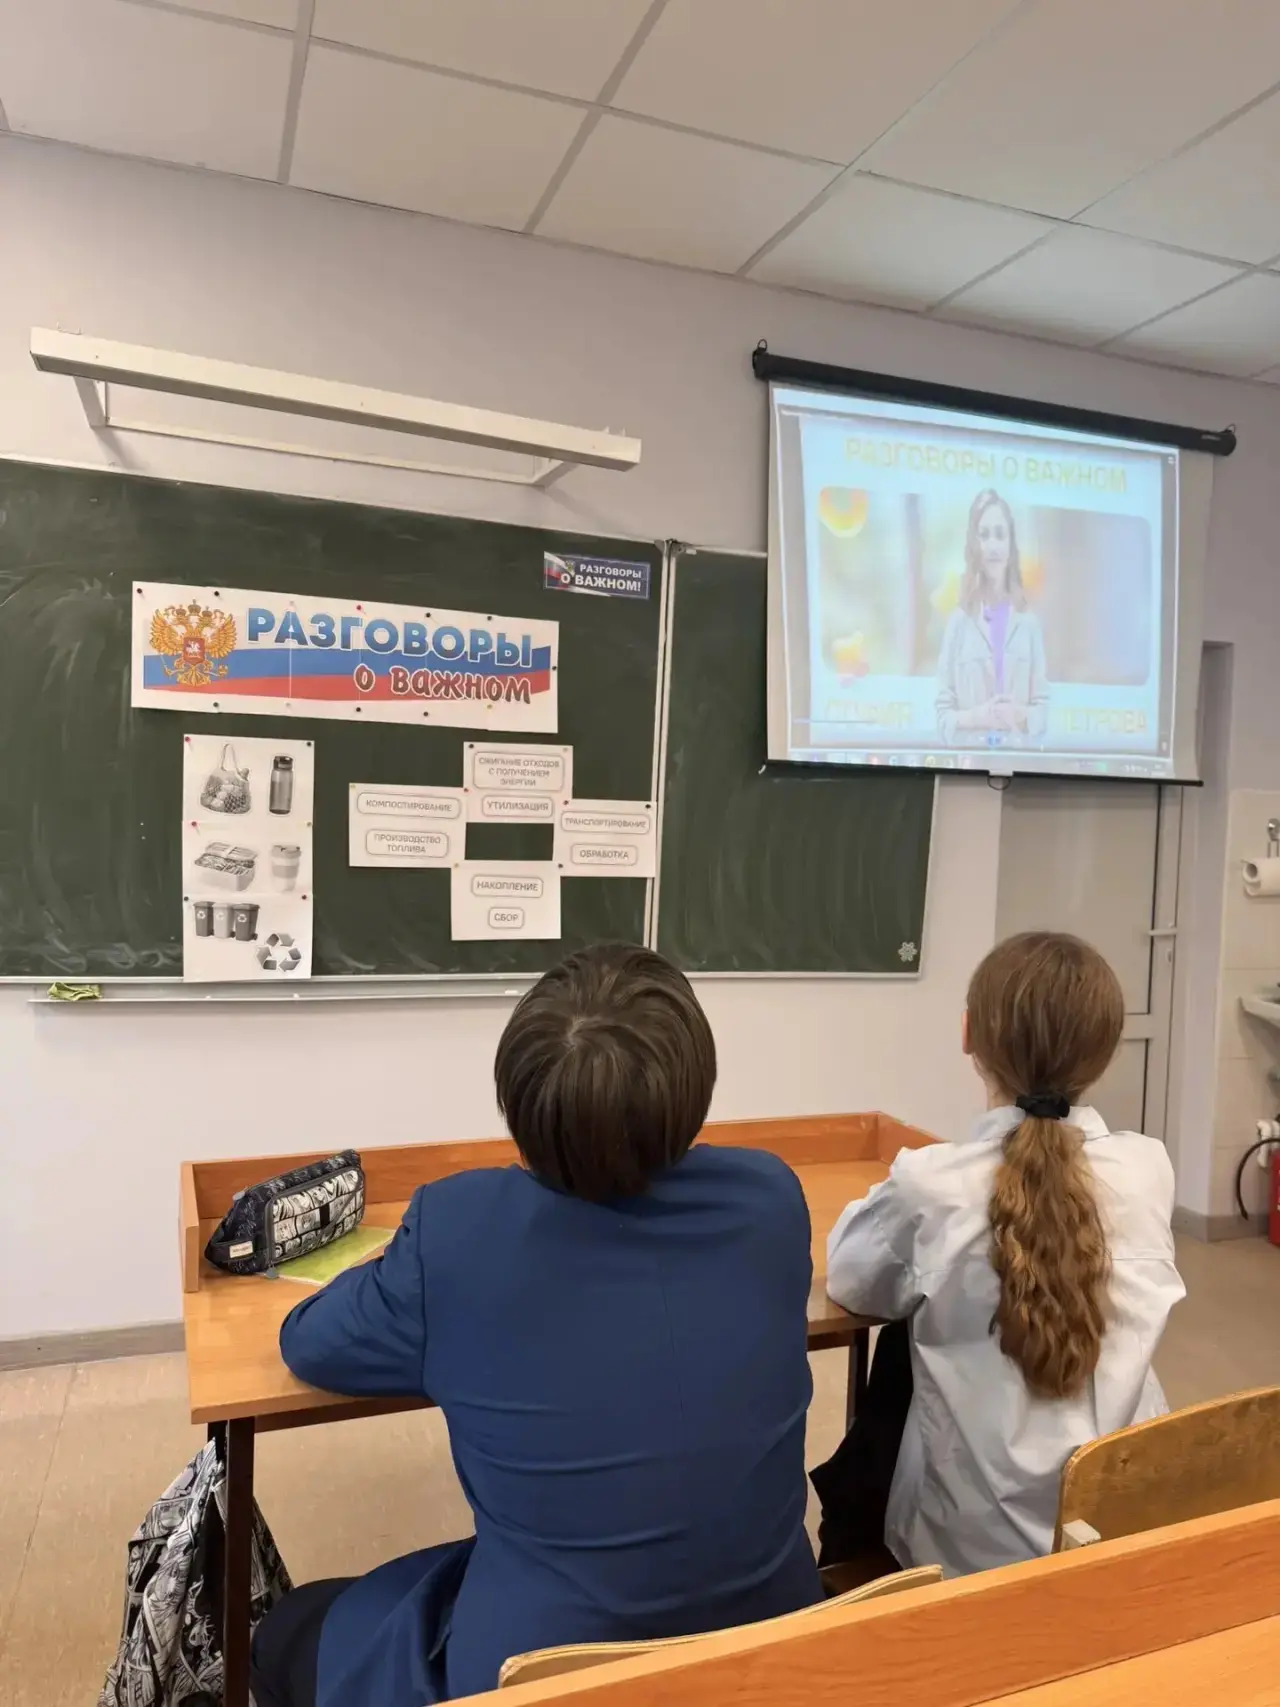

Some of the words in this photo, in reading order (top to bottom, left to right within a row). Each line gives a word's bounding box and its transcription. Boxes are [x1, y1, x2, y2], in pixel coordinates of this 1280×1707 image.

[845, 438, 995, 478] РАЗГОВОРЫ
[1002, 456, 1019, 480] О
[580, 563, 642, 578] РАЗГОВОРЫ
[560, 573, 571, 584] О
[575, 575, 641, 591] ВАЖНОМ!
[248, 607, 531, 667] РАЗГОВОРЫ
[523, 759, 559, 768] ОТХОДОВ
[496, 768, 550, 777] ПОЛУЧЕНИЕМ
[500, 778, 536, 787] ЭНЕРГИИ
[366, 799, 452, 811] КОМПОСТИРОВАНИЕ
[487, 801, 549, 811] УТИЛИЗАЦИЯ
[565, 817, 646, 828] ТРАНСПОРТИРОВАНИЕ
[374, 833, 441, 844] ПРОИЗВОДСТВО
[387, 844, 426, 853] ТОПЛИВА
[580, 849, 629, 859] ОБРАБОТКА
[477, 881, 539, 891] НАКОПЛЕНИЕ
[494, 913, 519, 922] СБОР
